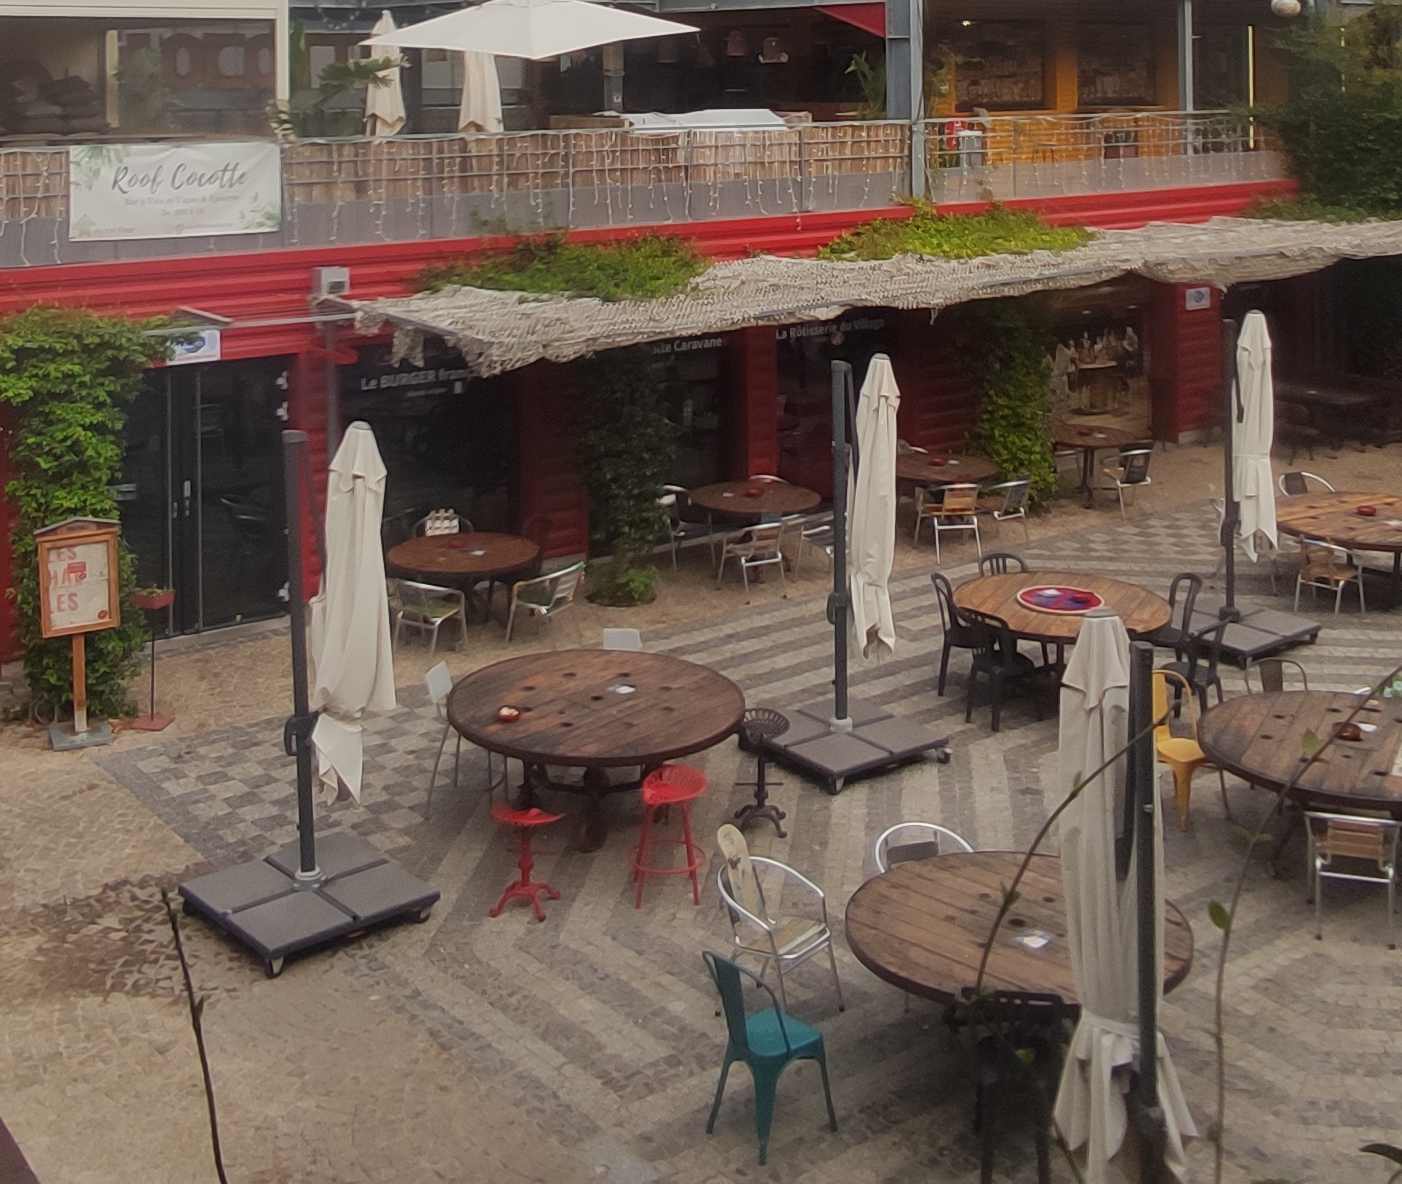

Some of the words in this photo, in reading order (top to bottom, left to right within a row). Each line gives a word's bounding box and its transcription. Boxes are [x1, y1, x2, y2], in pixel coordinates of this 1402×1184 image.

[111, 165, 165, 194] Roof
[171, 162, 249, 191] Cocotte
[674, 337, 723, 352] Caravane
[360, 377, 378, 391] Le
[380, 370, 437, 389] BURGER
